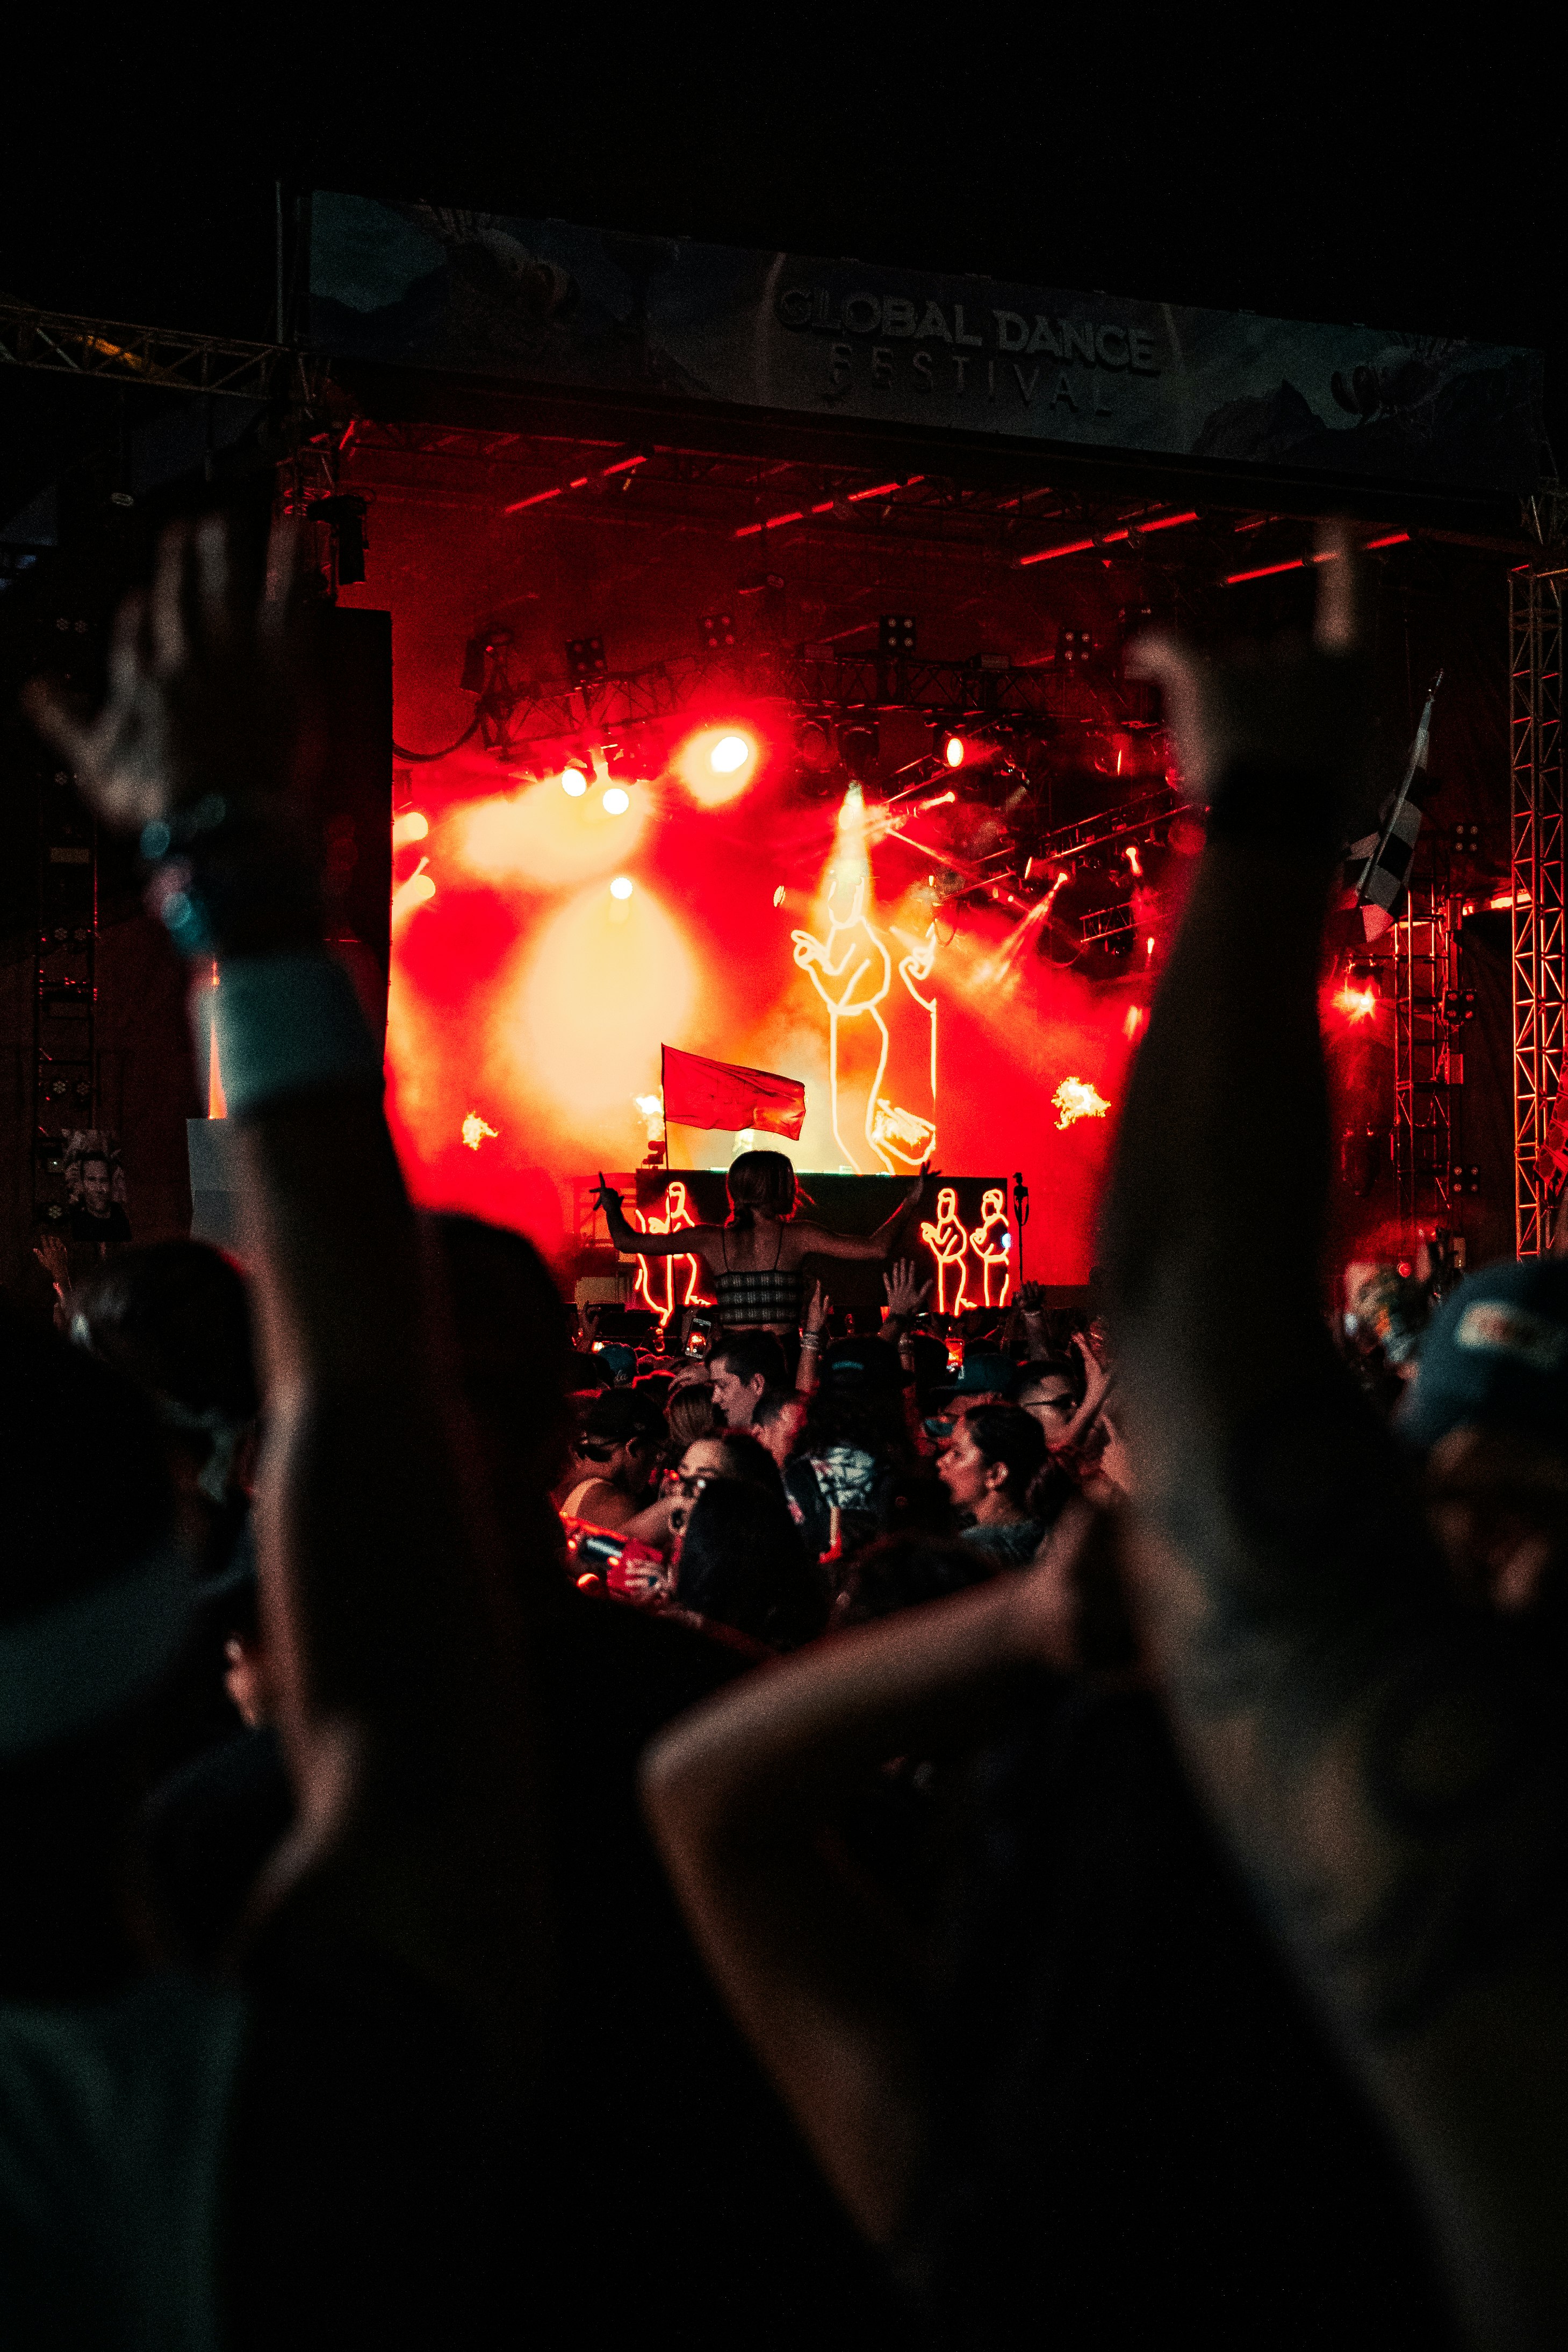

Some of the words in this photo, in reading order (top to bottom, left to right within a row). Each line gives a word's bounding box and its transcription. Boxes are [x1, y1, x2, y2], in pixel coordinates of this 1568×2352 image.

[777, 288, 983, 348] GLOBAL
[993, 308, 1157, 375] DANCE
[828, 342, 1113, 417] FESTIVAL
